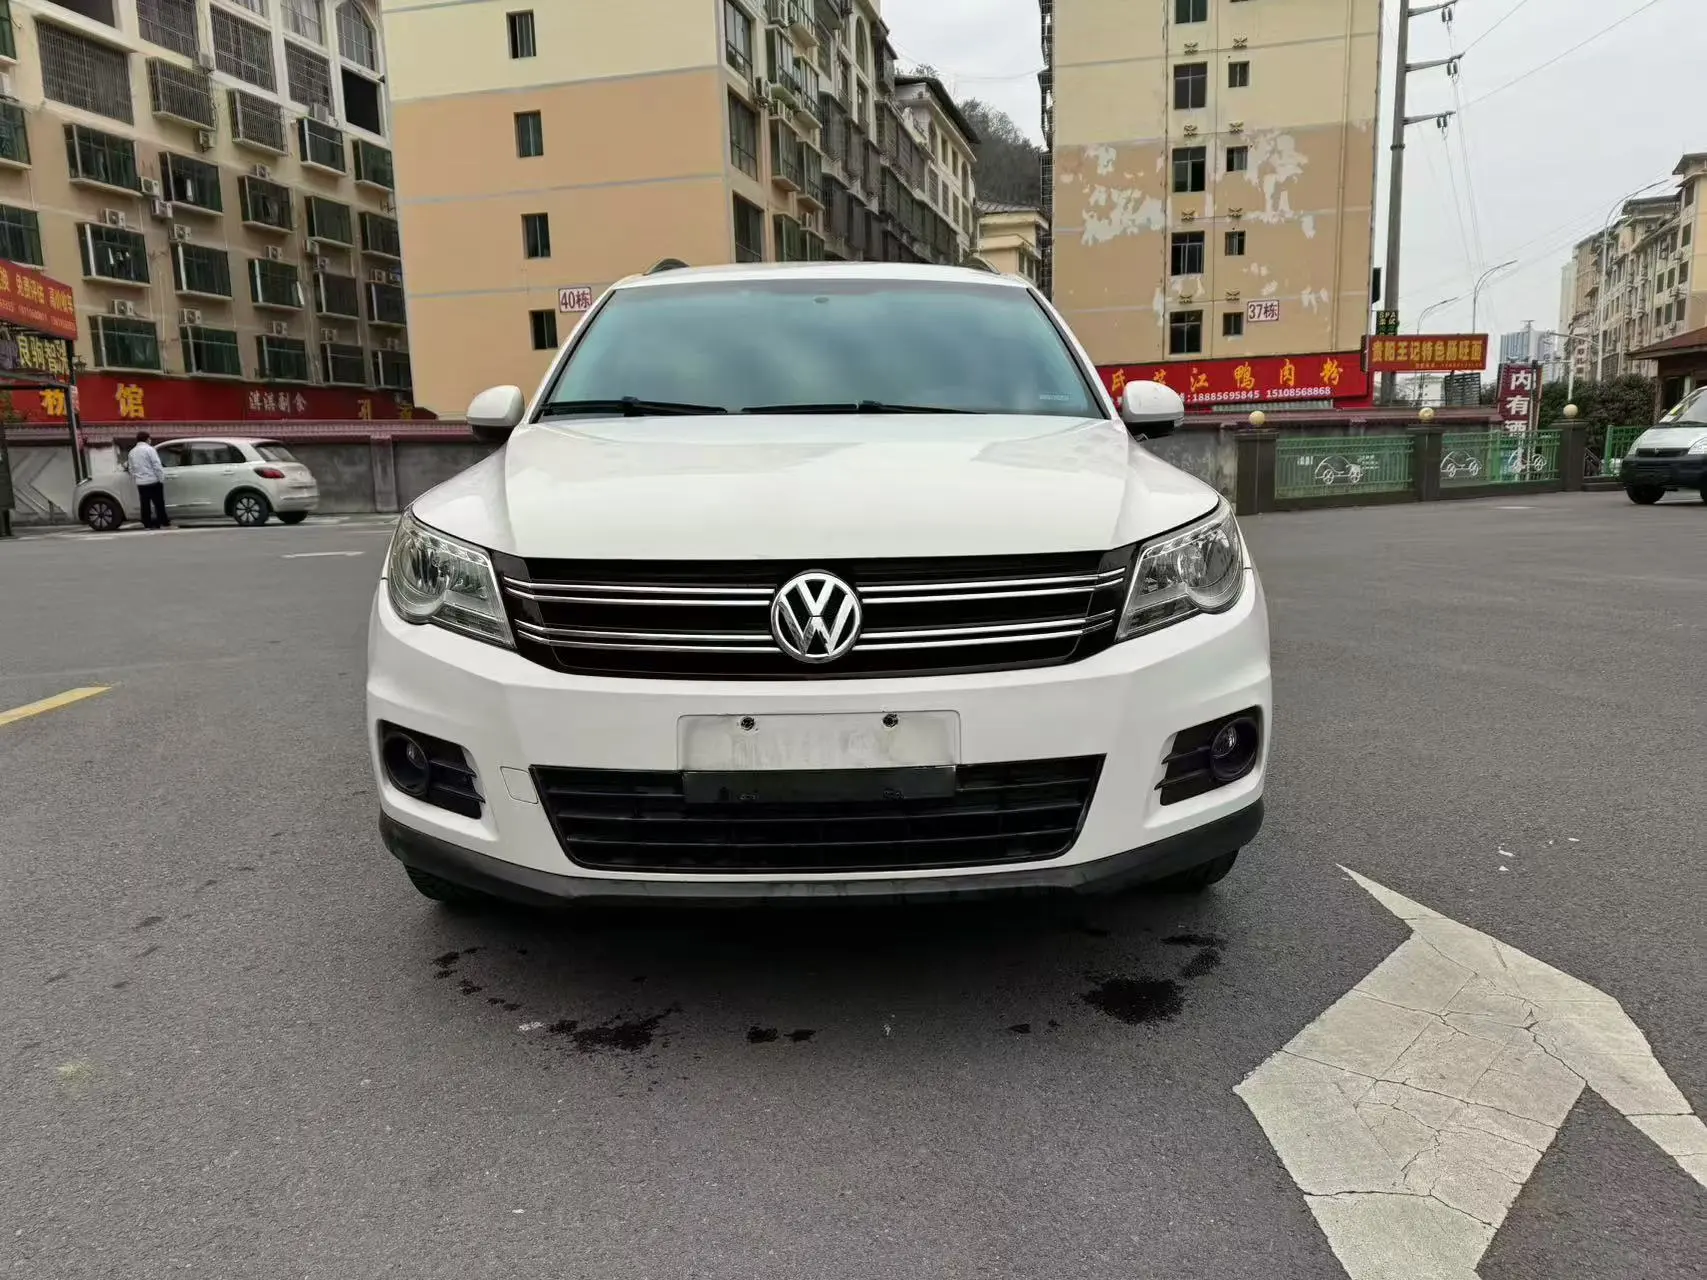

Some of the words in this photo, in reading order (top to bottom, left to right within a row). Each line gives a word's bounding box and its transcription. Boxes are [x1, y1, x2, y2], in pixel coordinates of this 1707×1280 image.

[561, 291, 592, 309] 40栋
[1249, 303, 1278, 319] 37栋
[1266, 387, 1331, 398] 15108568868
[776, 575, 858, 660] VW
